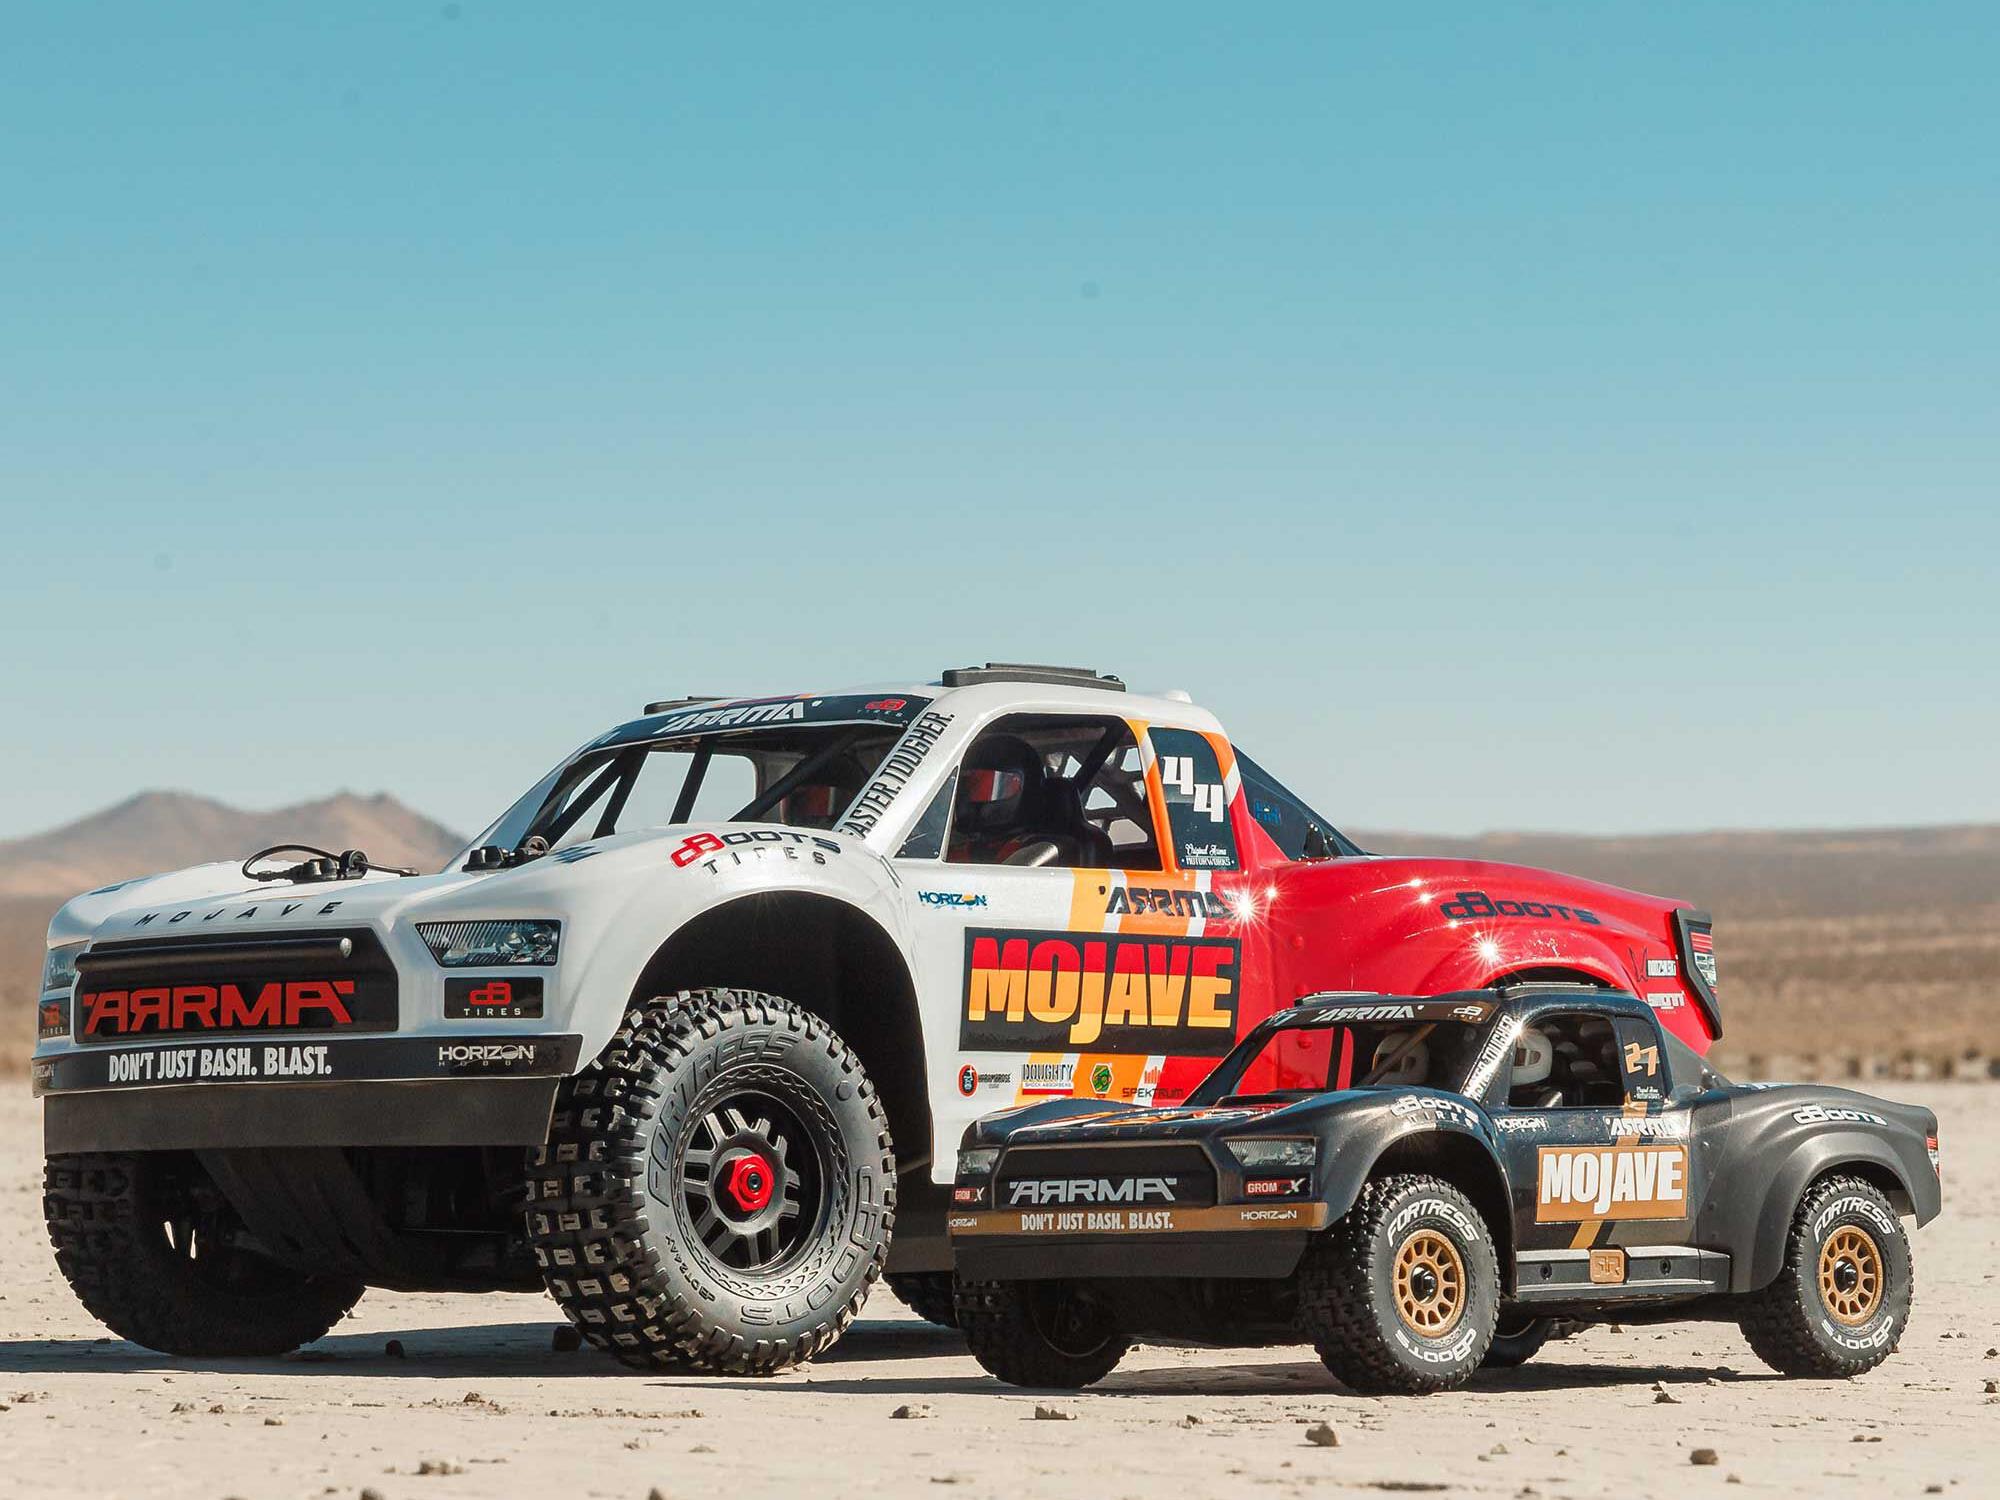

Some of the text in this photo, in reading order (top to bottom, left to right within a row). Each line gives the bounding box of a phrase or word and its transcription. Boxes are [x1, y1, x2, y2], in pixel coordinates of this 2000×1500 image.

[652, 701, 823, 735] ARRMA
[878, 712, 955, 784] TOUGHER.
[1161, 756, 1224, 822] 44
[134, 902, 344, 926] MOJAVE
[918, 891, 988, 907] HORIZON
[967, 936, 1235, 1044] MOJAVE
[83, 980, 354, 1035] ARRMA
[464, 1008, 522, 1016] TIRES
[1310, 1004, 1425, 1023] ARRMA
[109, 1046, 332, 1083] DON'T JUST BASH. BLAST.
[439, 1044, 535, 1061] HORIZON
[1023, 1063, 1074, 1080] DOUGHTY
[648, 1029, 801, 1207] FORTRESS
[1009, 1178, 1178, 1205] ARRMA
[1247, 1182, 1278, 1193] GROM
[1540, 1151, 1684, 1215] MOJAVE
[1021, 1212, 1173, 1231] DON'T JUST BASH. BLAST.
[1241, 1210, 1297, 1220] HORIZON
[1387, 1198, 1480, 1247] FORTRESS
[1814, 1196, 1896, 1244] FORTRESS
